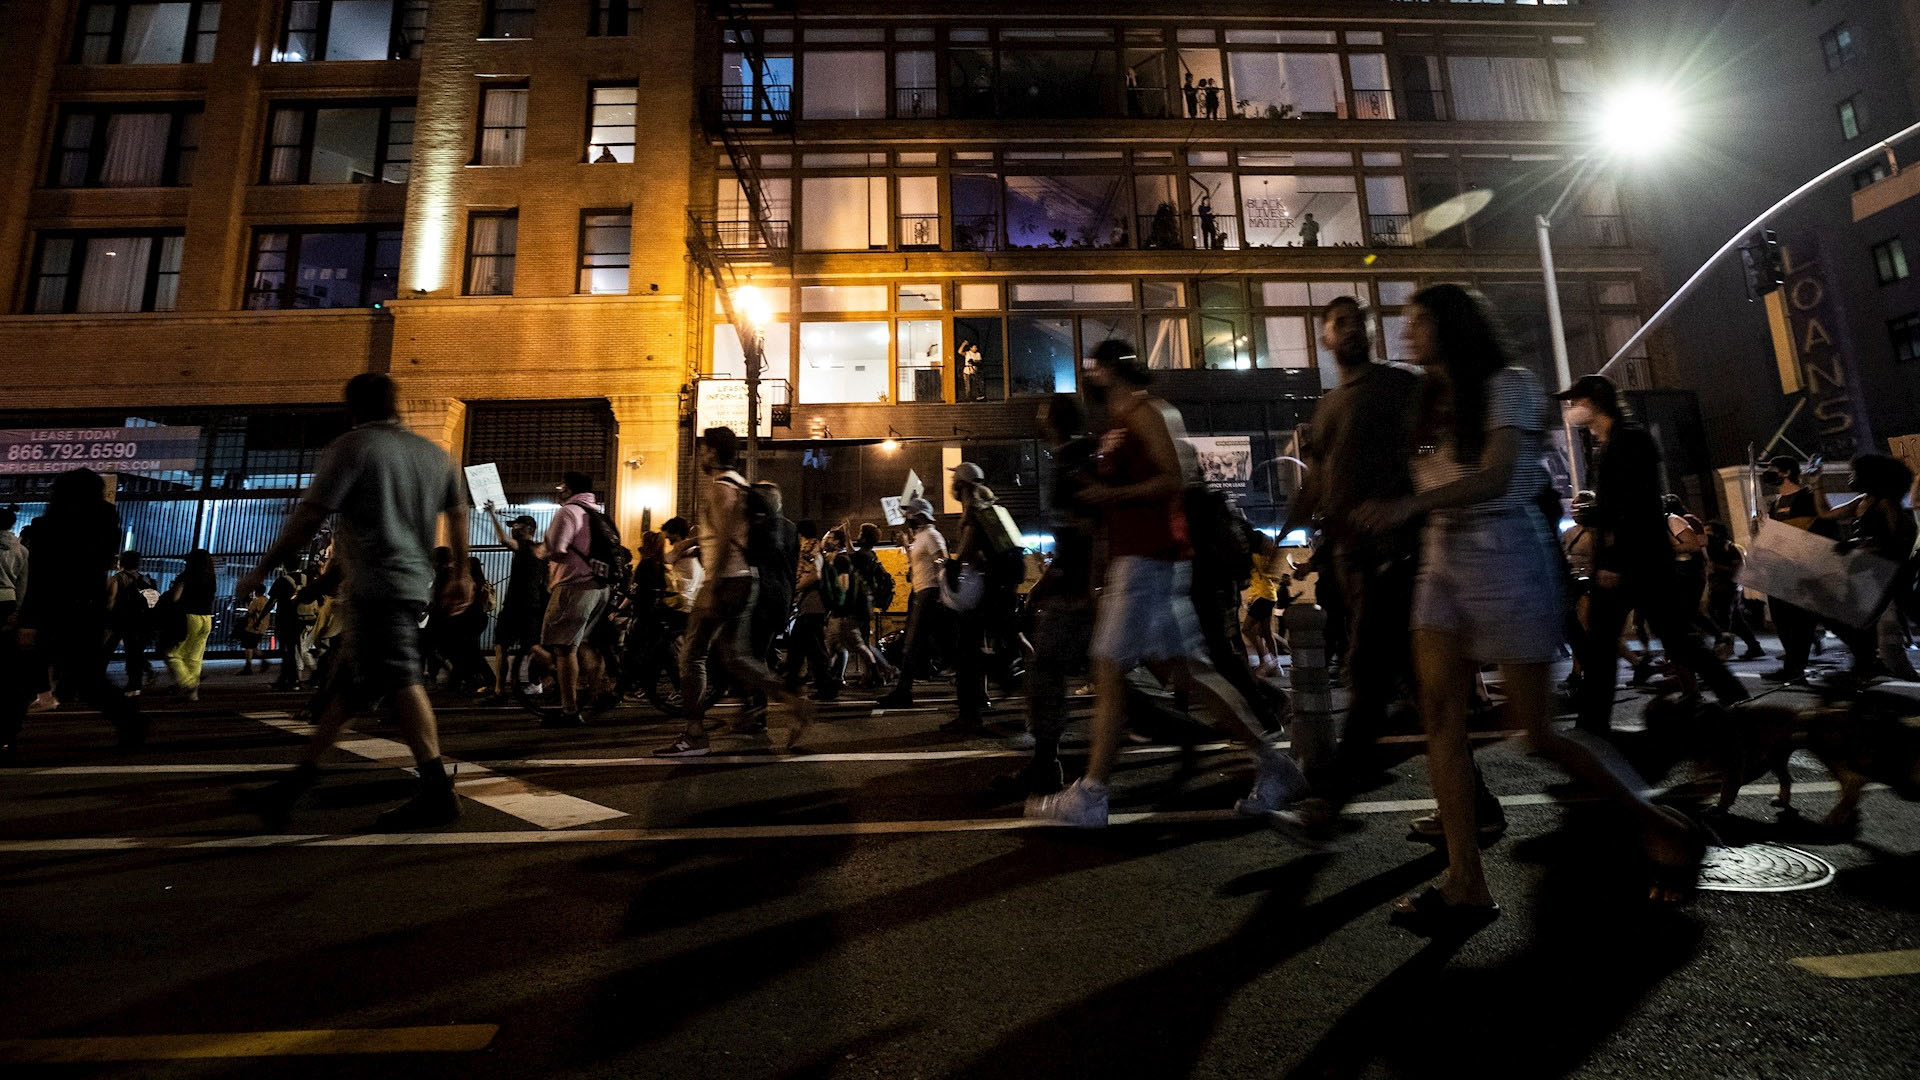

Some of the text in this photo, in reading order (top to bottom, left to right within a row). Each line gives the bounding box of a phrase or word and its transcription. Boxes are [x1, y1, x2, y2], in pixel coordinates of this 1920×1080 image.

[1247, 199, 1284, 208] BLACK
[1249, 208, 1285, 217] LIVES
[1249, 218, 1295, 228] MATTER
[1781, 246, 1853, 436] LOANS
[31, 430, 120, 441] LEASE TODAY
[8, 442, 137, 460] 866.792.6590
